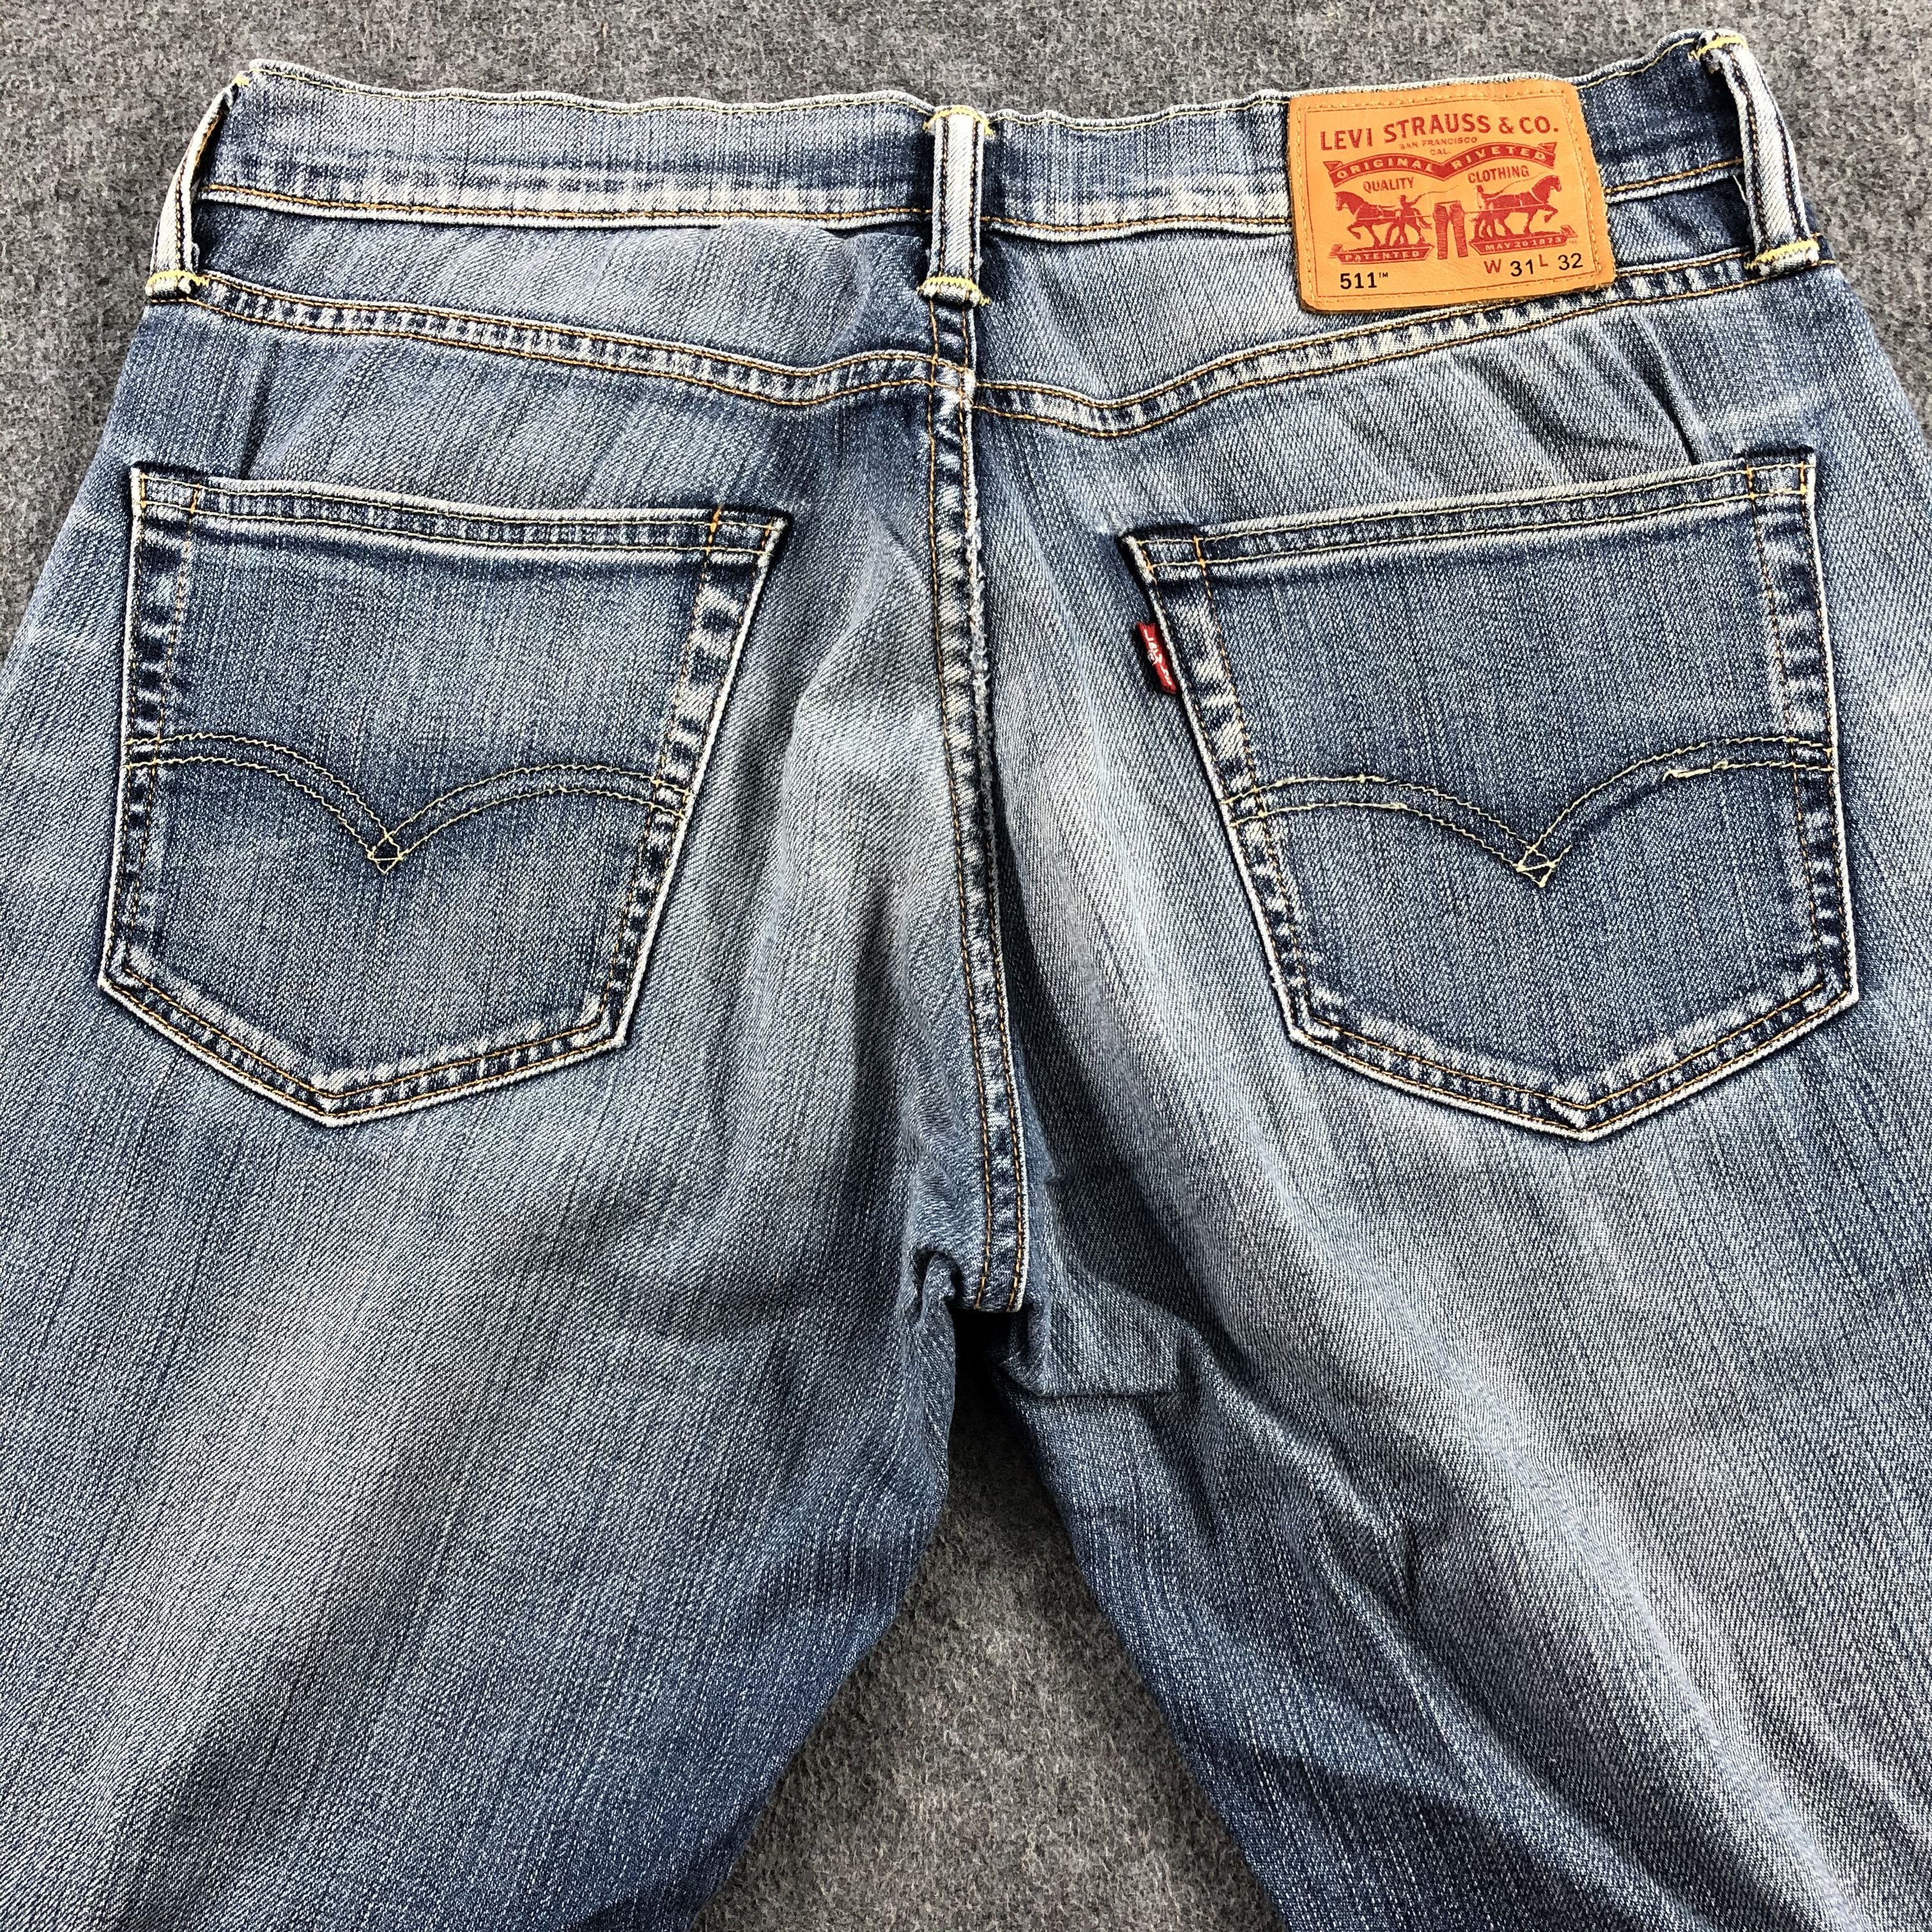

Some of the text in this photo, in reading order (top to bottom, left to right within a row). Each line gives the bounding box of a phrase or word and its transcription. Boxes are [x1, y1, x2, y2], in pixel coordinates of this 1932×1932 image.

[1320, 113, 1559, 151] LEVI STRAUSS & CO.
[1399, 137, 1478, 150] SAN FRANCISCO
[1337, 146, 1547, 179] ORIGINAL RIVETED
[1363, 165, 1530, 192] QUALITY CLOTHING
[1345, 250, 1420, 263] PATENTED
[1485, 243, 1511, 252] MAY
[1483, 252, 1584, 277] W 31 L 32
